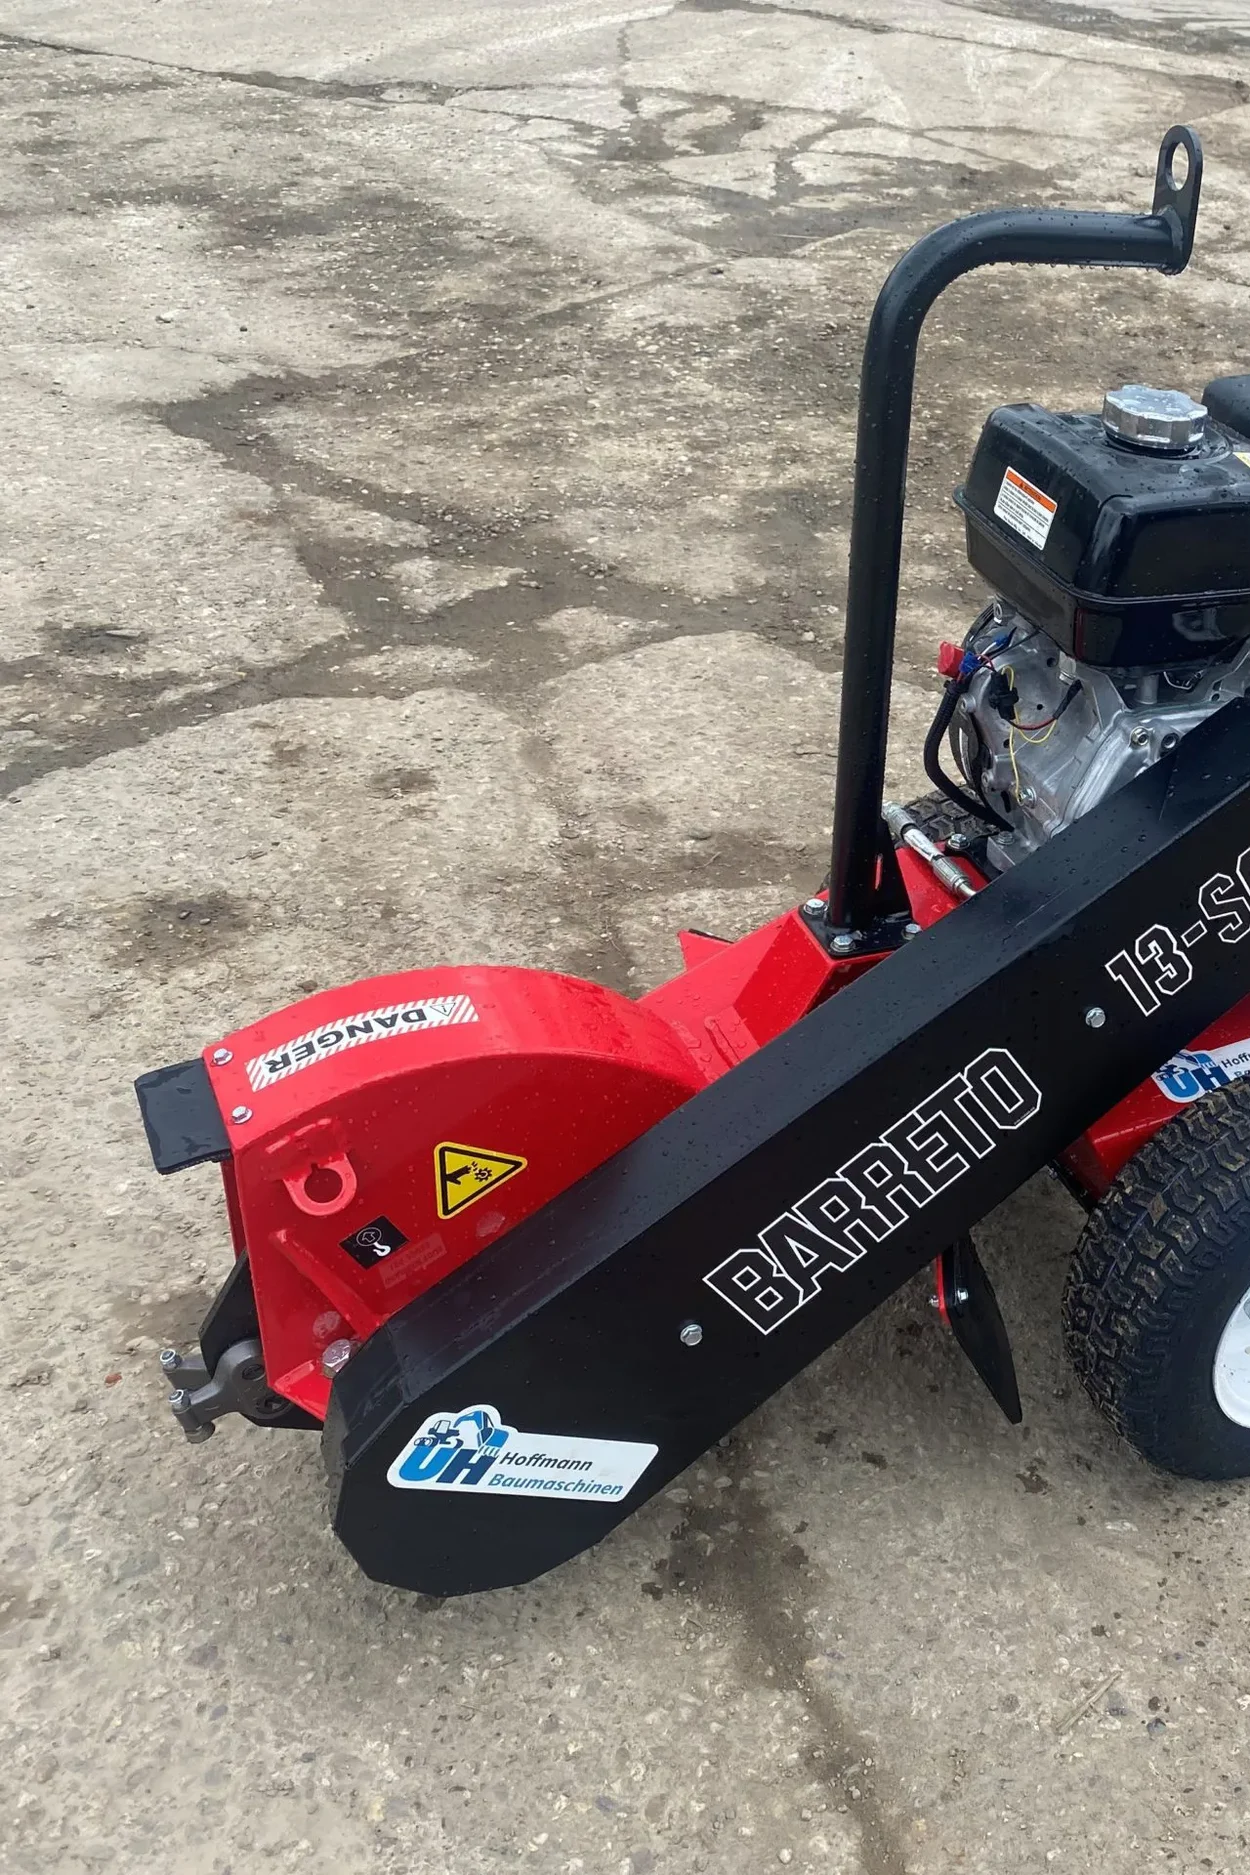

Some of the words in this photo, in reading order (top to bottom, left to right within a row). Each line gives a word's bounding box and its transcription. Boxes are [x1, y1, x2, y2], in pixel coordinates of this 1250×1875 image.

[262, 1008, 428, 1075] DANGER
[702, 1047, 1042, 1335] BARRETO
[499, 1451, 593, 1472] Hoffmann
[488, 1473, 624, 1497] Baumaschinen
